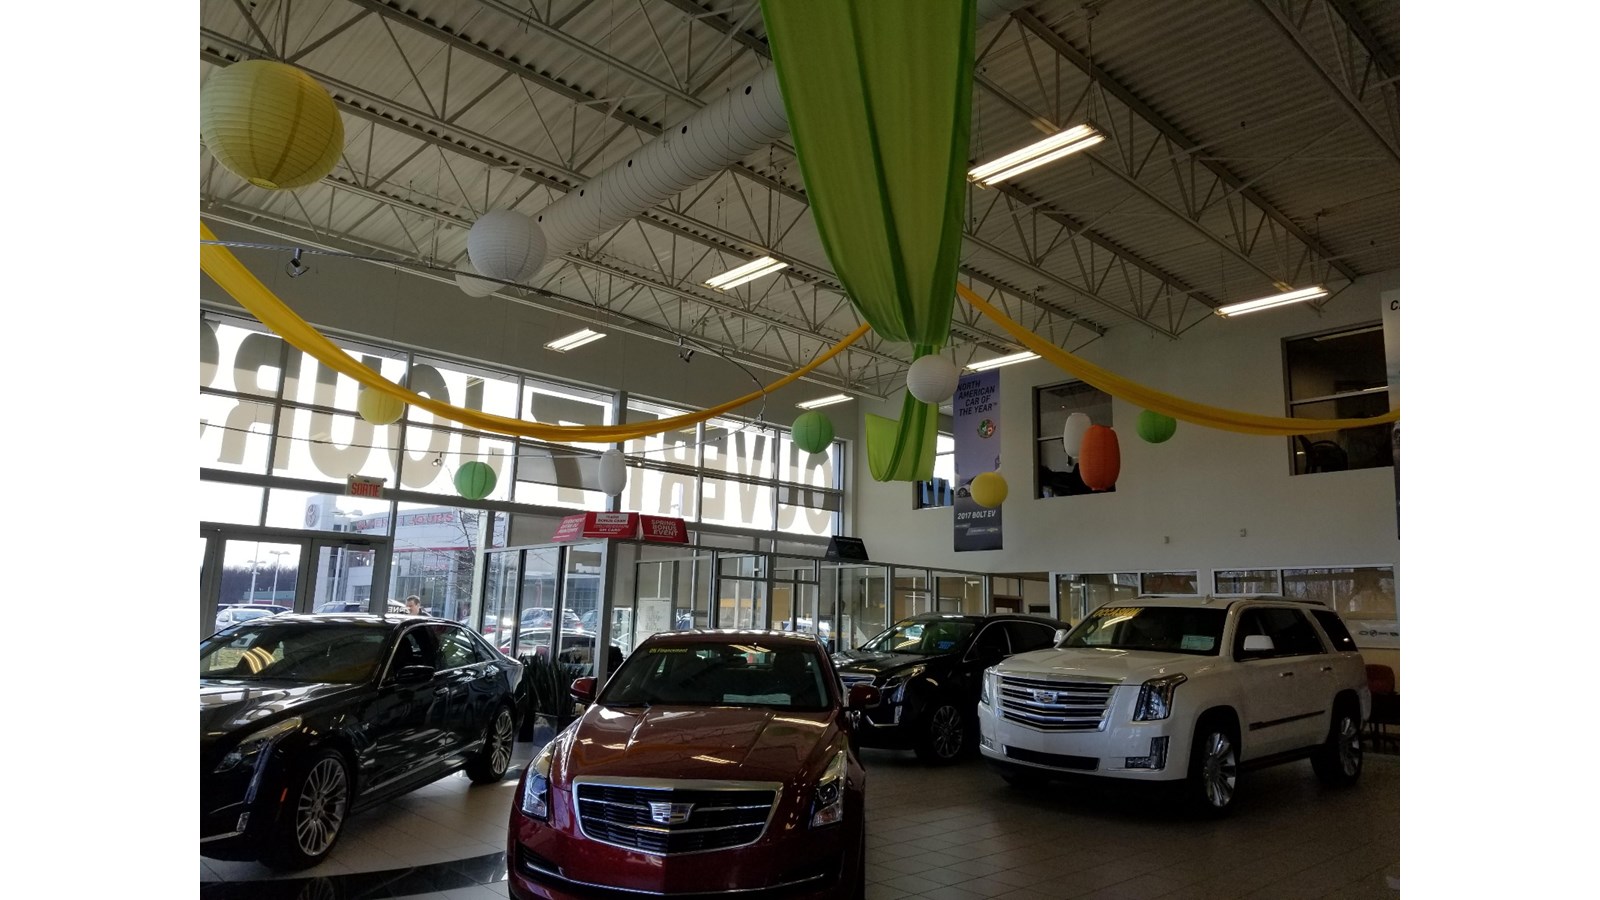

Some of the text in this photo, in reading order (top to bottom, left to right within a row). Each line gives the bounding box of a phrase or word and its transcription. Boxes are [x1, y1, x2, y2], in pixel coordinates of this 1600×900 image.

[957, 380, 980, 391] NORTH
[958, 385, 996, 400] AMERICAN
[965, 394, 991, 407] CAR OF
[959, 403, 992, 417] THE YEAR
[351, 482, 381, 497] SORTIE
[957, 510, 996, 520] 2017 BOLT EV
